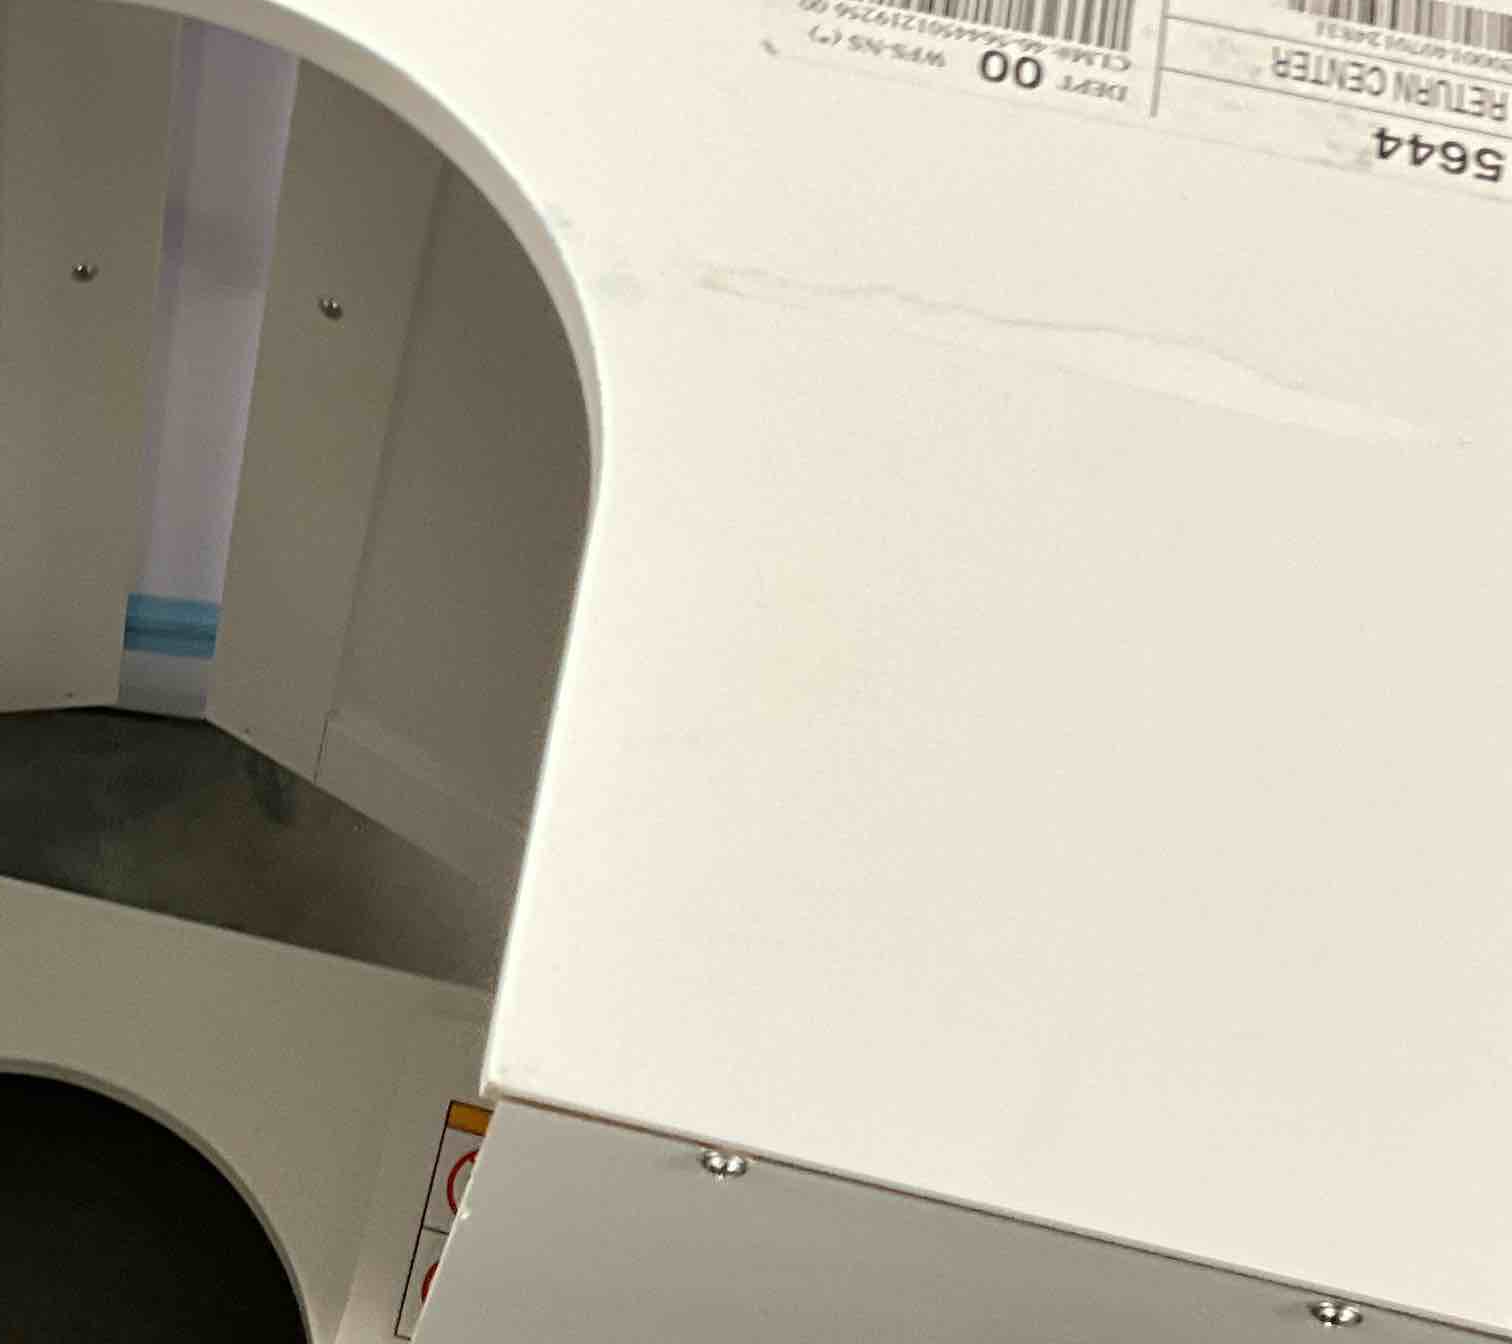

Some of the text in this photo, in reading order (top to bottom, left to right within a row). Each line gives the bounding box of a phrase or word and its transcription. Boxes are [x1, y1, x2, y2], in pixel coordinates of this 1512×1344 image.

[980, 49, 1044, 90] 00
[1055, 75, 1129, 102] DEPT
[1271, 45, 1509, 122] RETURN CENTER
[1371, 126, 1507, 183] 5644
